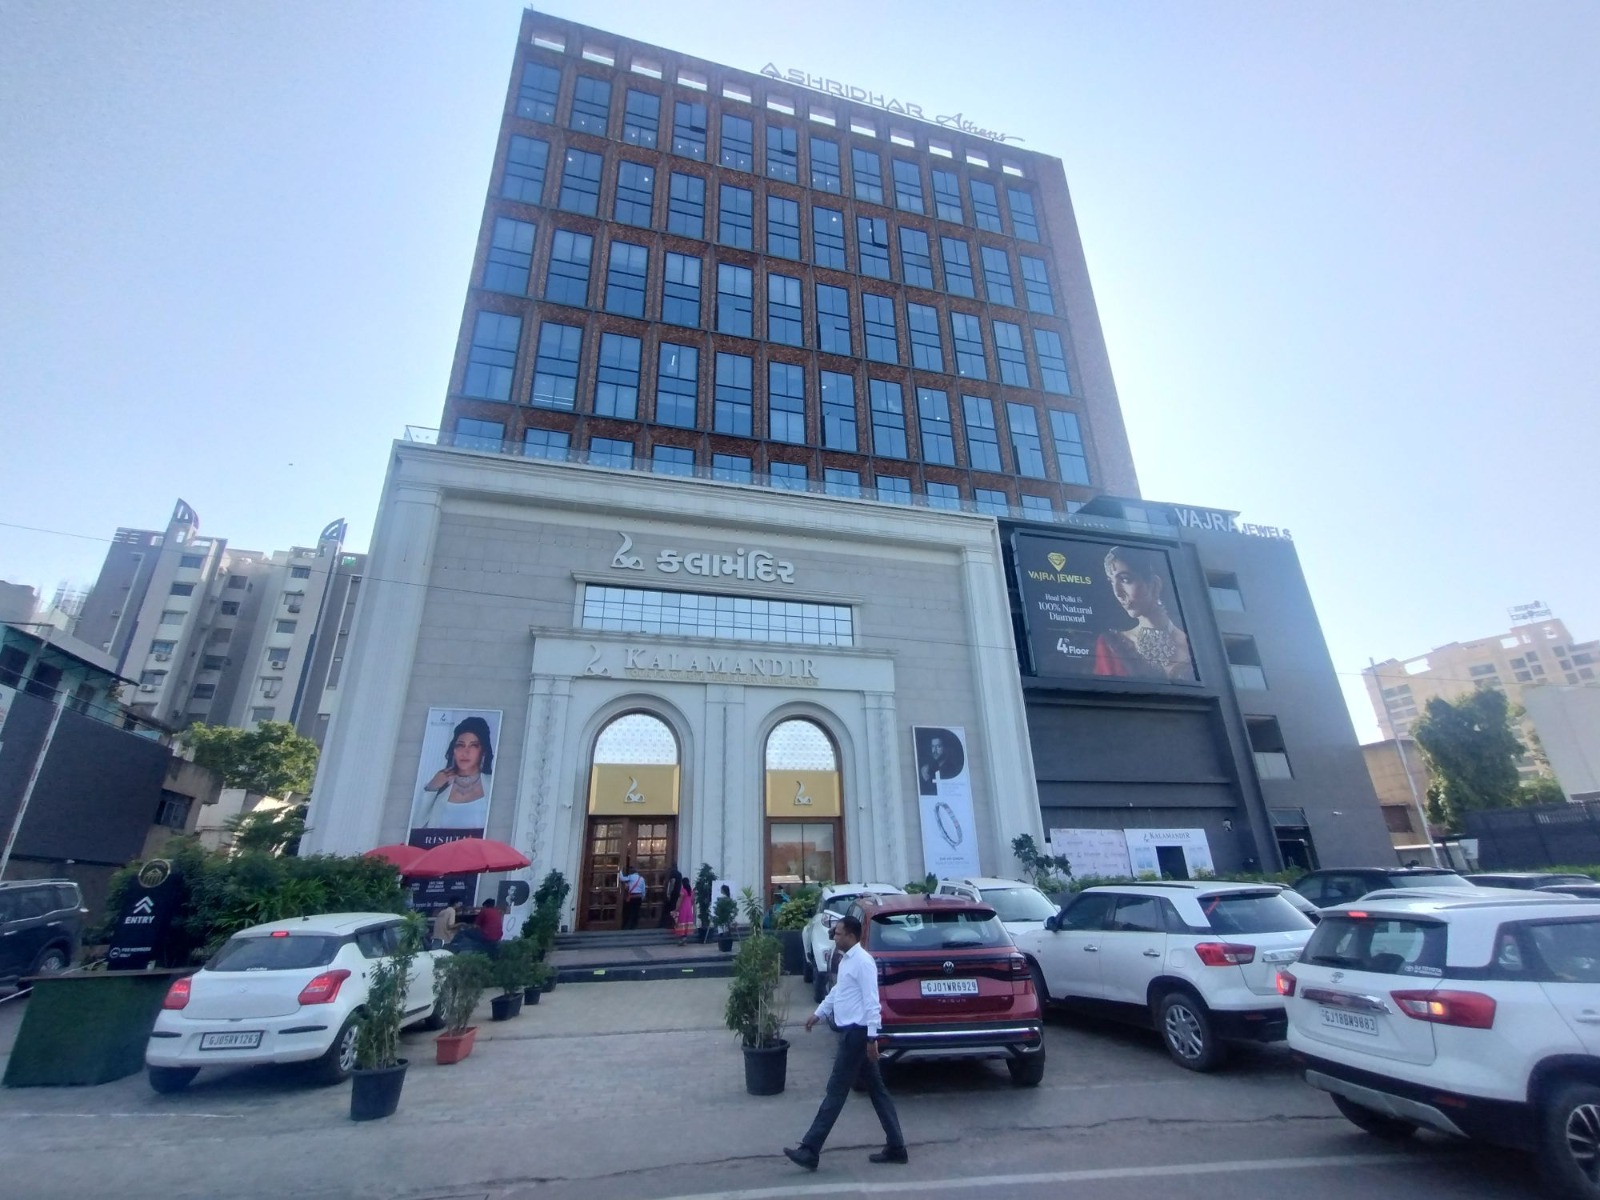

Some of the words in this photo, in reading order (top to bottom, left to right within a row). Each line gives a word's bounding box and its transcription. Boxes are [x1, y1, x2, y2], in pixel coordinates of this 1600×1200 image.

[1174, 507, 1242, 534] VAJRA
[1242, 522, 1292, 541] JEWELS
[656, 547, 795, 584] કલામંદિર
[1028, 570, 1056, 582] VAJRA
[1057, 573, 1092, 585] JEWELS
[1038, 601, 1061, 612] 100%
[1062, 603, 1093, 615] Natural
[1049, 611, 1086, 623] Diamond
[1068, 645, 1090, 656] Floor
[623, 648, 819, 680] KALAMANDIR
[124, 916, 155, 925] ENTRY
[926, 981, 977, 993] GJ01WR6929
